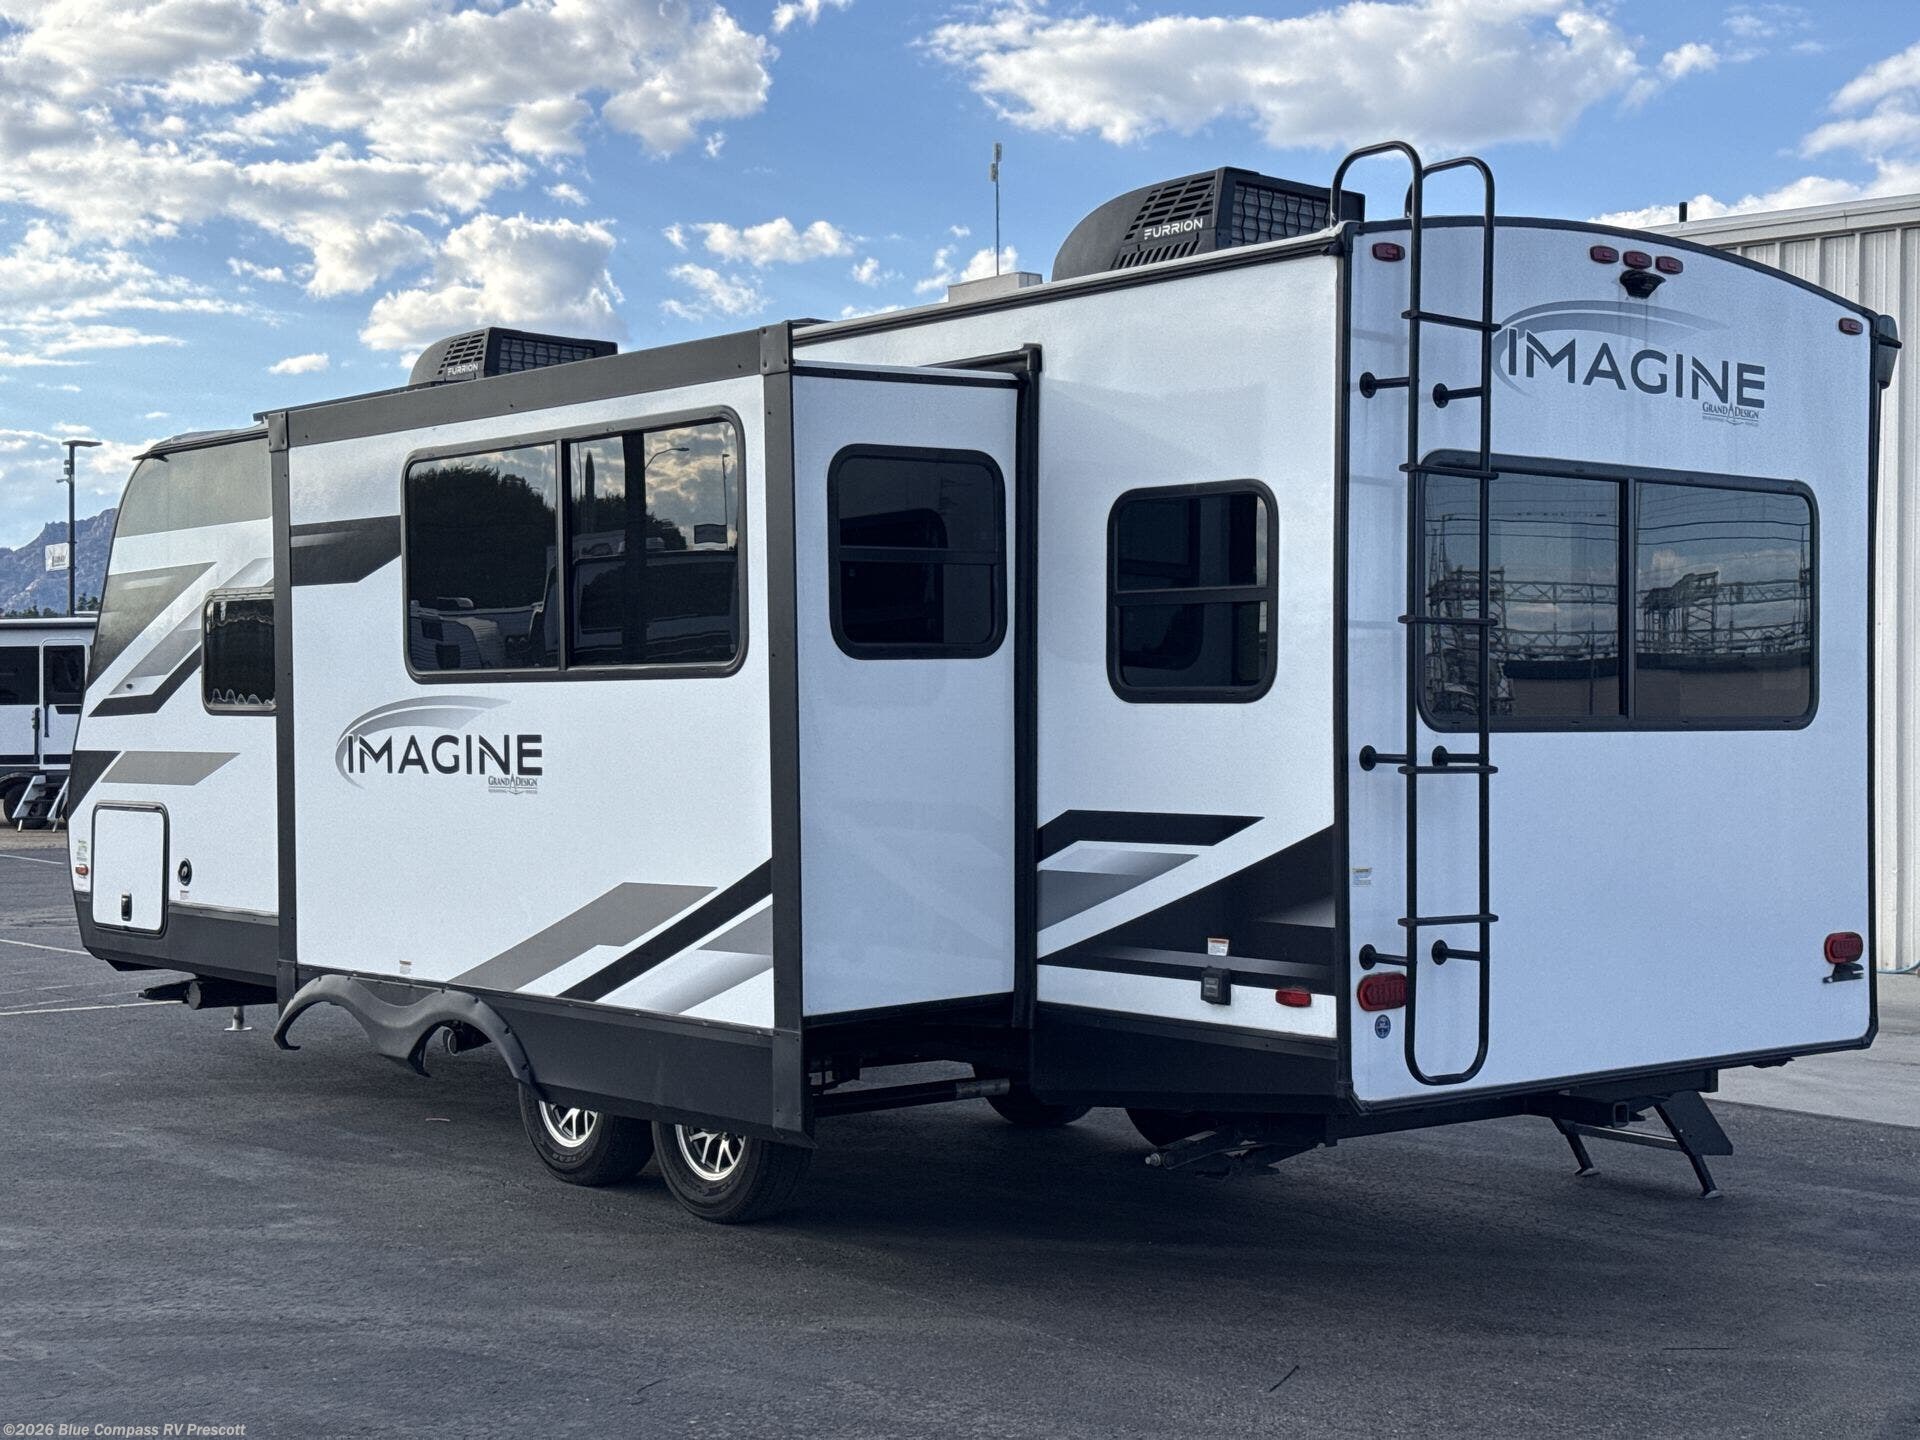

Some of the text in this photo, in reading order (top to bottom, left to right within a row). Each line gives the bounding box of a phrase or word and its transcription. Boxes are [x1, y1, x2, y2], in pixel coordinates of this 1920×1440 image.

[1144, 217, 1203, 240] FURRION
[1508, 328, 1765, 409] IMAGINE
[1702, 401, 1728, 415] GRAND
[347, 734, 543, 776] IMAGINE
